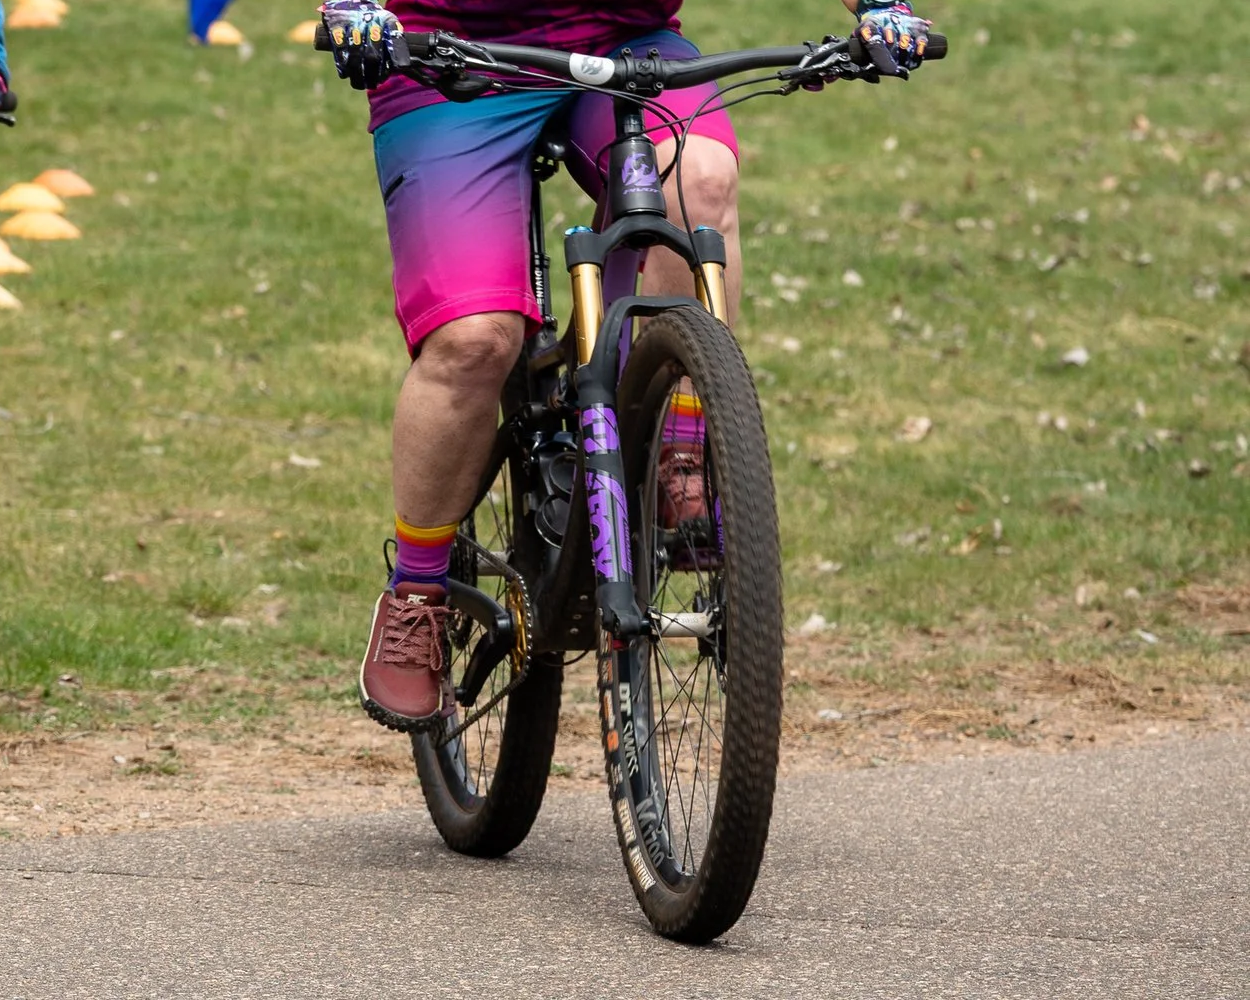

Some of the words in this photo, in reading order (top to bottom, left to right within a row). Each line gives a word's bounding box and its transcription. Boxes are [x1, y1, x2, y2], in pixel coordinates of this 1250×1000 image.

[619, 682, 632, 717] DT
[622, 720, 639, 778] SWISS
[636, 797, 665, 868] M1700
